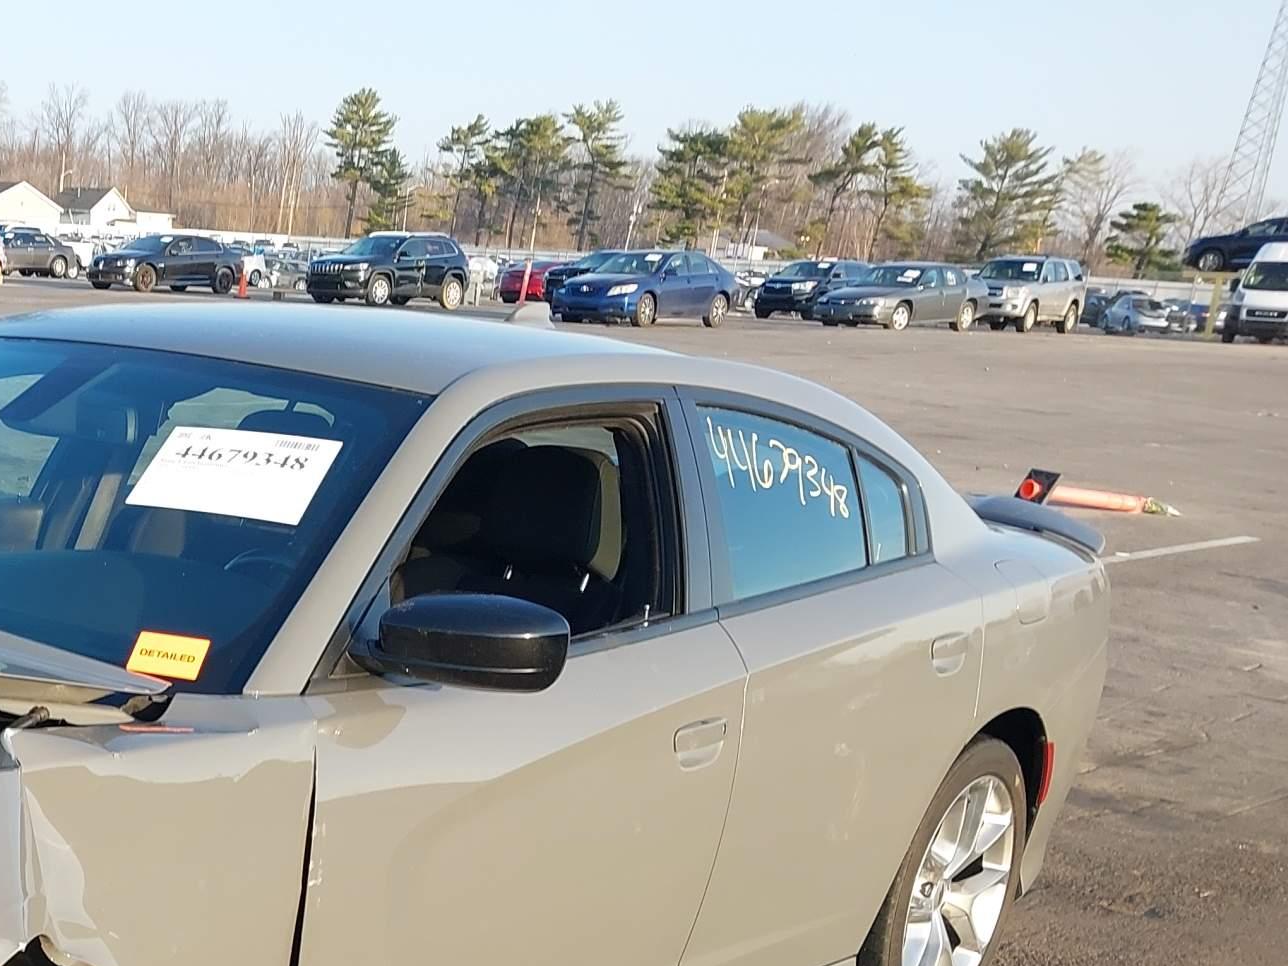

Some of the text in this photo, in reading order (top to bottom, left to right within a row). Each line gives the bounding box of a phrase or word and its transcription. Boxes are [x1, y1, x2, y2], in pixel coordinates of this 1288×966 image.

[175, 445, 309, 471] 44679348
[706, 416, 850, 518] 44679348
[139, 647, 196, 663] DETAILED
